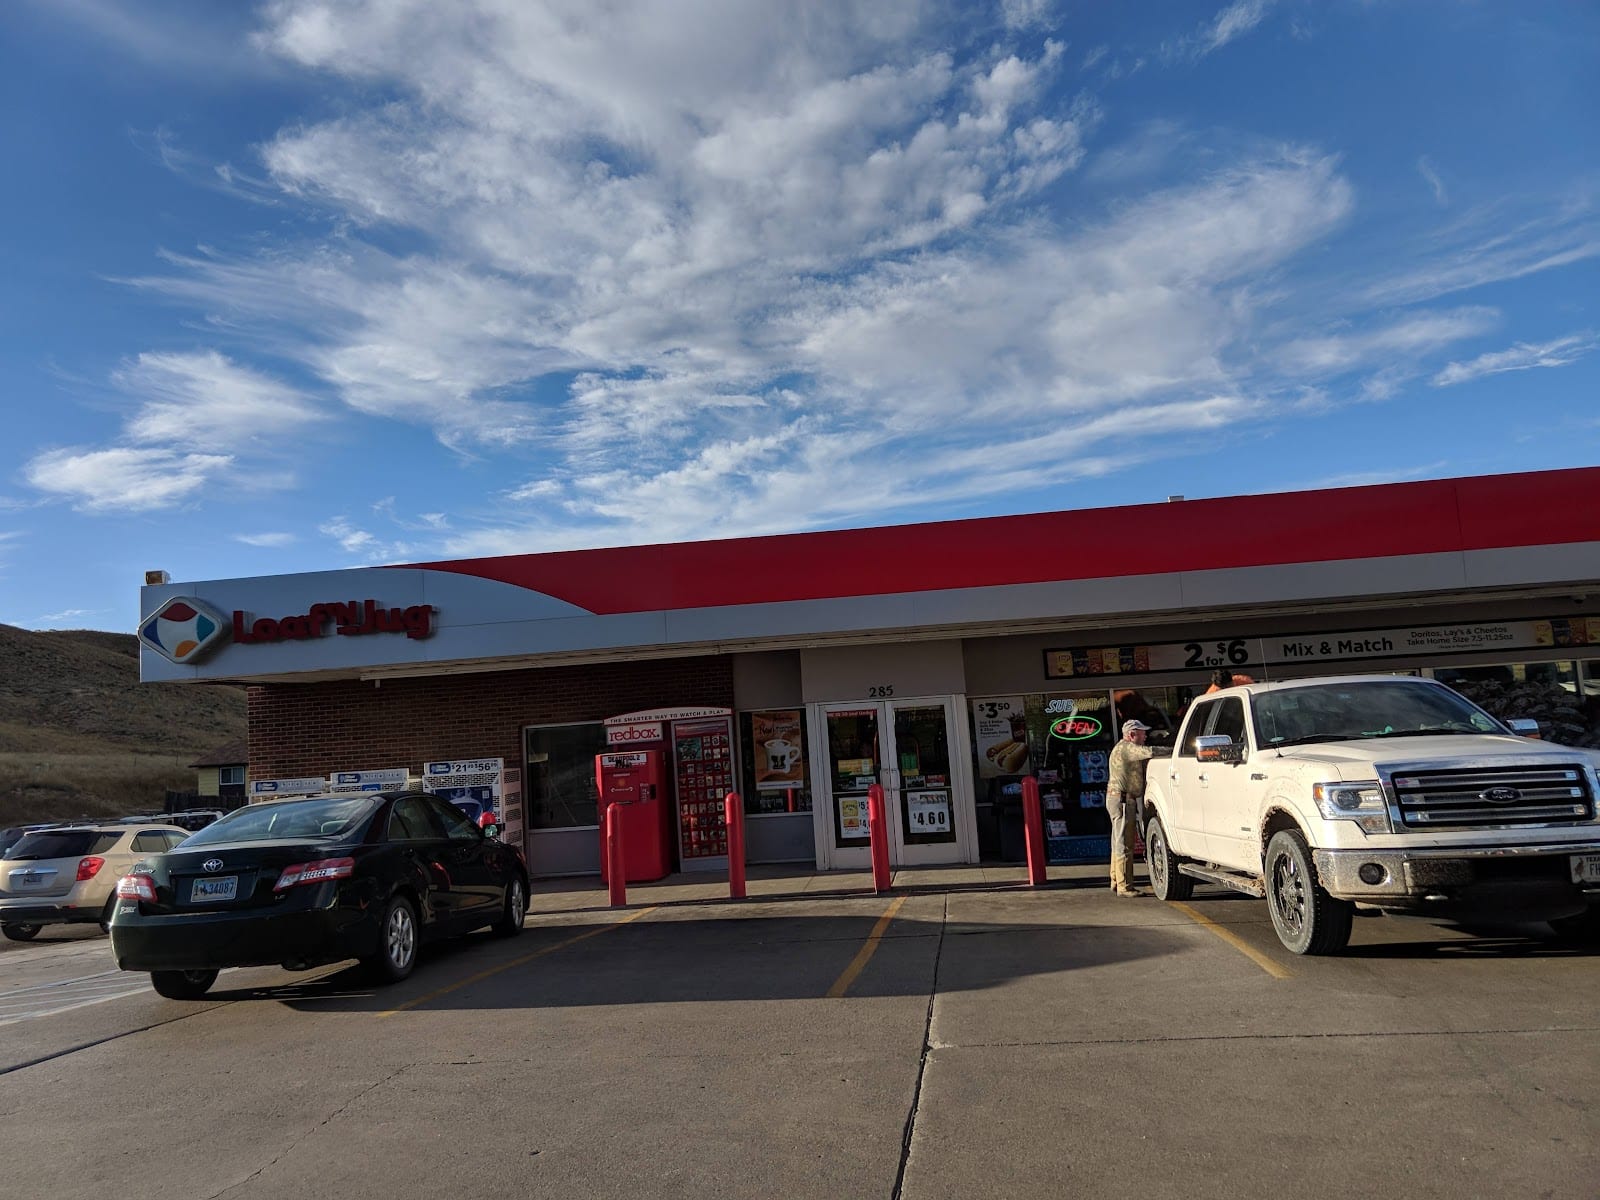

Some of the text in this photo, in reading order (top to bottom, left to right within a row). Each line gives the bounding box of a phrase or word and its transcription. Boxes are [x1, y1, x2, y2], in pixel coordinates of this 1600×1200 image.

[233, 603, 330, 642] Loaf
[337, 600, 431, 639] Jug
[1410, 630, 1443, 638] Doritos,
[1474, 626, 1507, 634] Cheetos
[1427, 637, 1451, 645] Home
[1184, 643, 1204, 667] 2
[1205, 656, 1225, 666] for
[1283, 643, 1314, 657] Mix
[1320, 641, 1332, 655] &
[1337, 637, 1393, 654] Match
[869, 685, 894, 697] 285
[1044, 697, 1107, 714] SUBWAY
[1055, 721, 1096, 735] OPEN
[913, 811, 945, 825] $4.60
